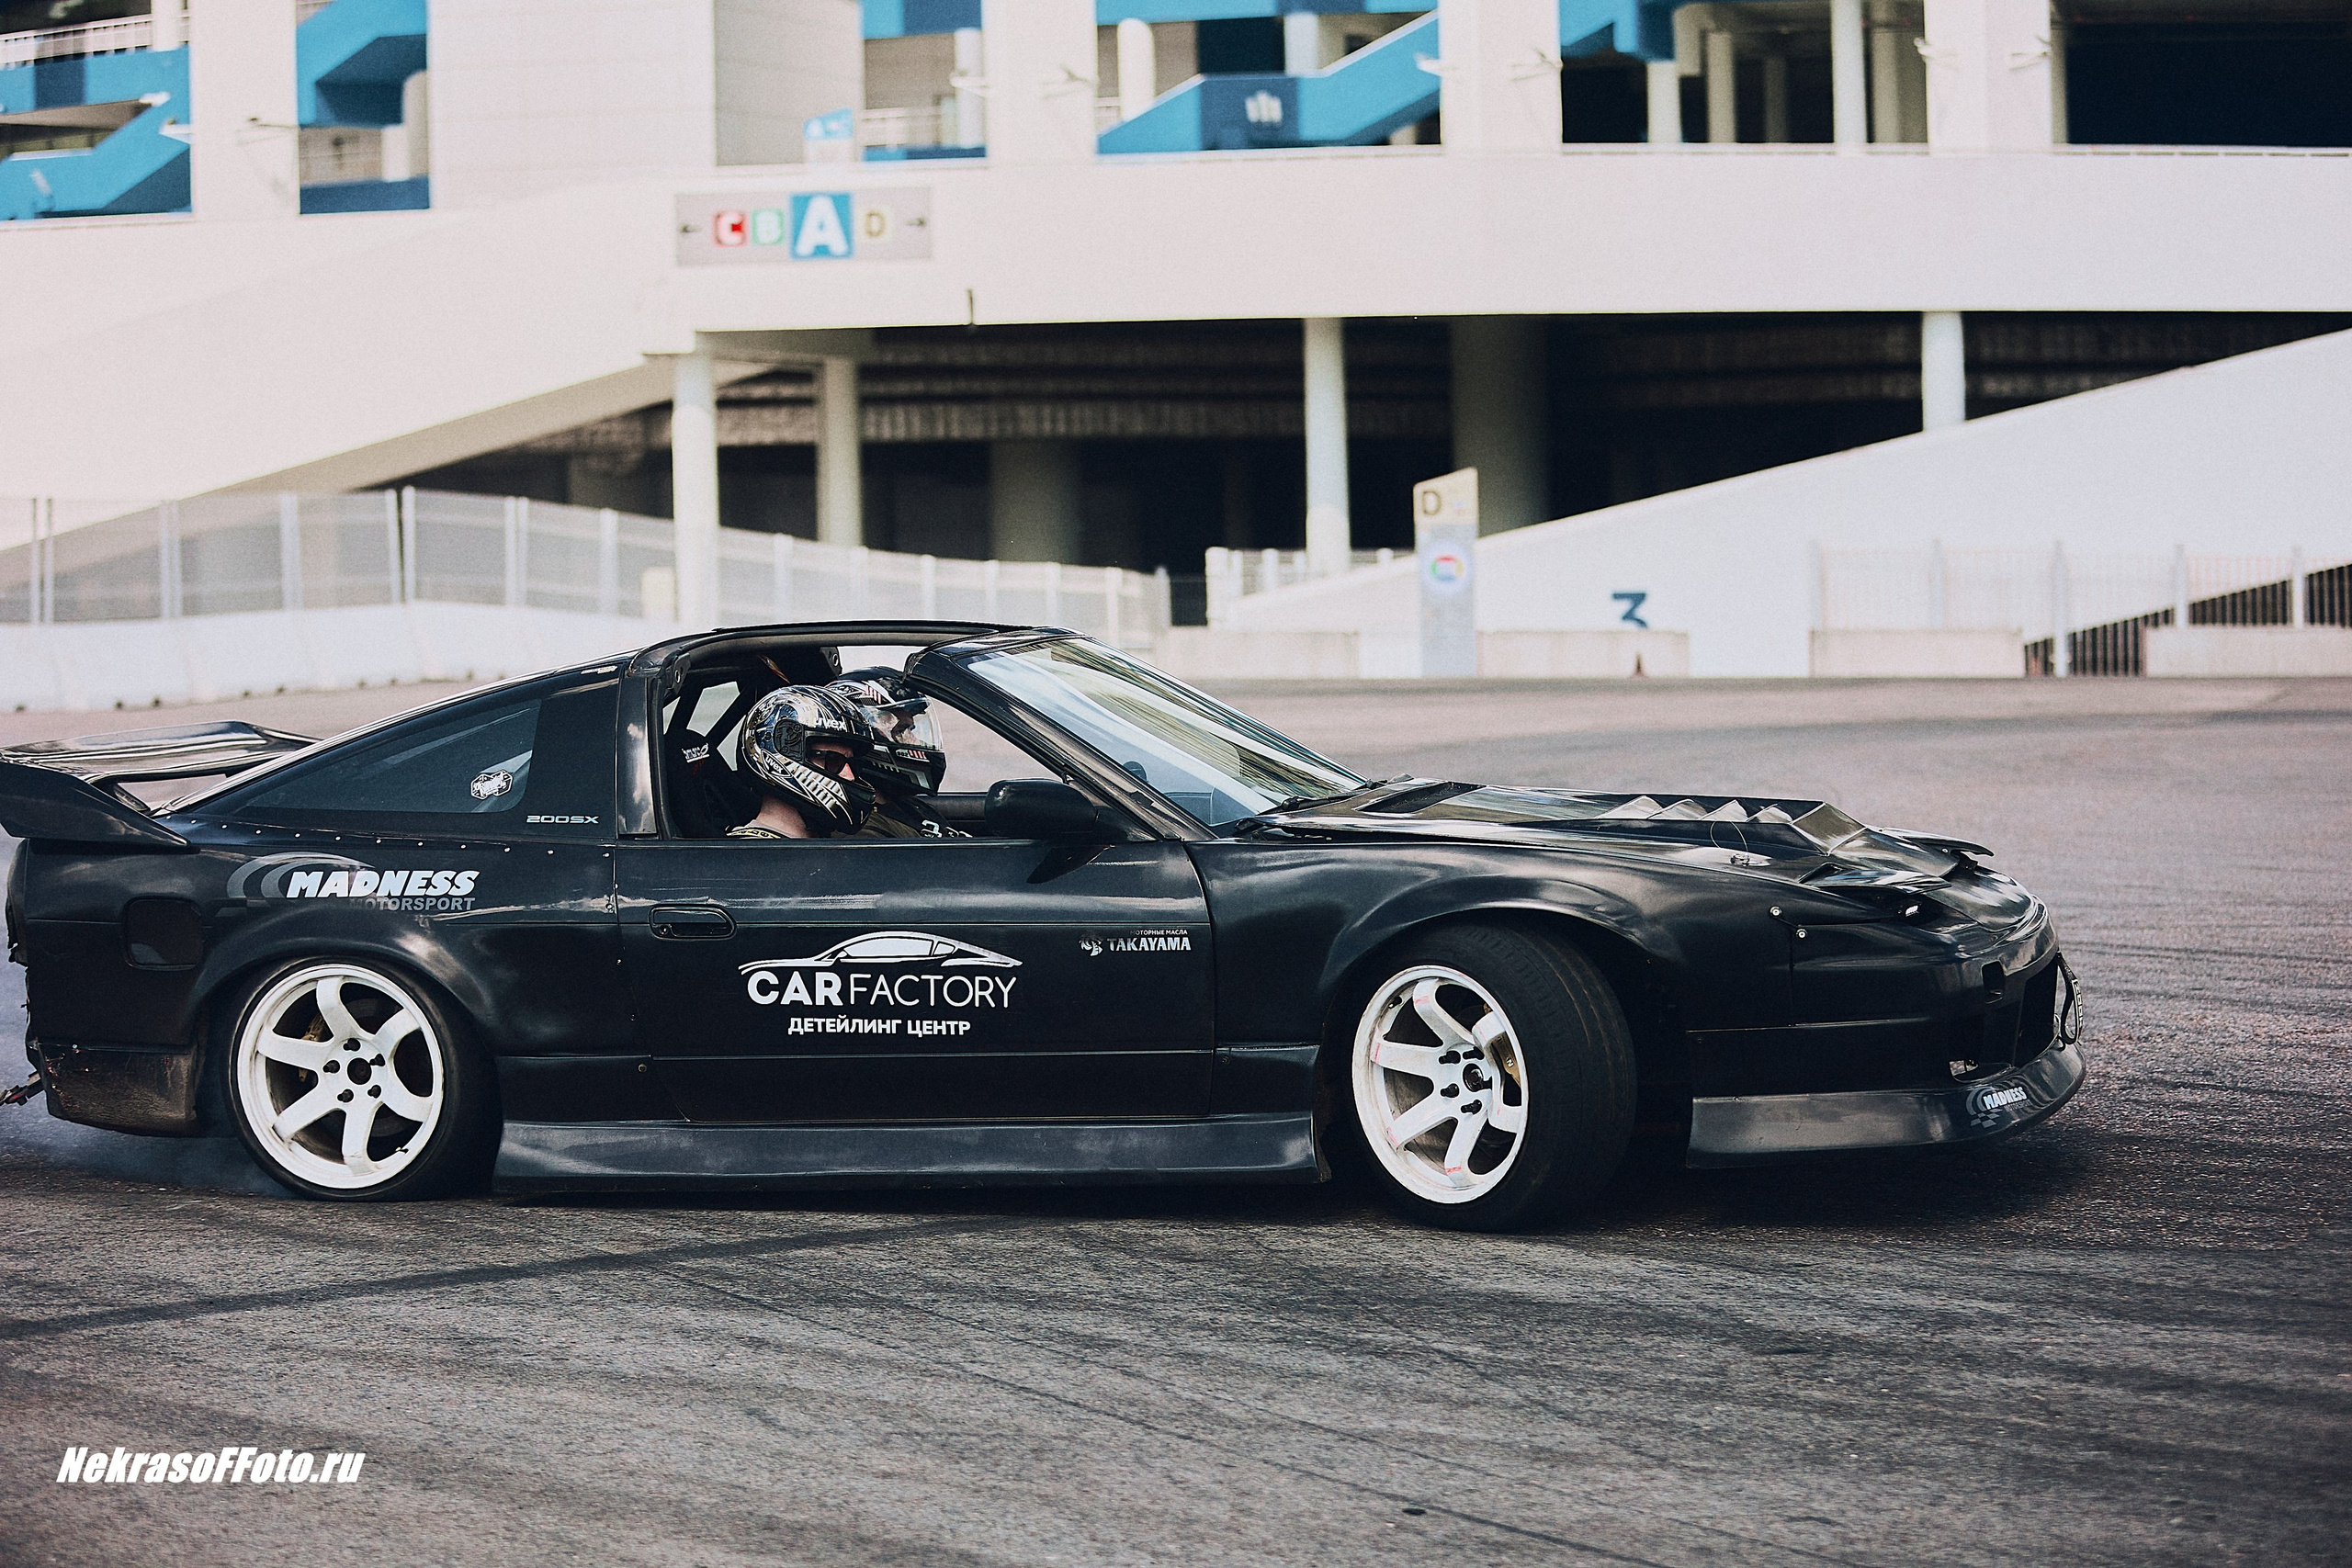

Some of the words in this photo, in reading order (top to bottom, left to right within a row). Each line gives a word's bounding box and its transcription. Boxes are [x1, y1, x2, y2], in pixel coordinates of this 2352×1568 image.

[716, 211, 745, 245] C
[795, 195, 849, 256] A
[865, 211, 885, 238] D
[1422, 489, 1442, 516] D
[813, 716, 847, 733] uvex
[765, 754, 785, 774] uvex
[526, 815, 599, 824] 200SX
[286, 870, 480, 898] MADNESS
[350, 897, 476, 911] MOTORSPORT
[1106, 937, 1192, 952] TAKAYAMA
[747, 970, 843, 1007] CAR
[849, 974, 1017, 1009] FACTORY
[787, 1014, 902, 1036] ДЕТЕЙЛИНГ
[907, 1020, 971, 1038] ЦЕНТР
[1983, 1087, 2028, 1111] MADNESS
